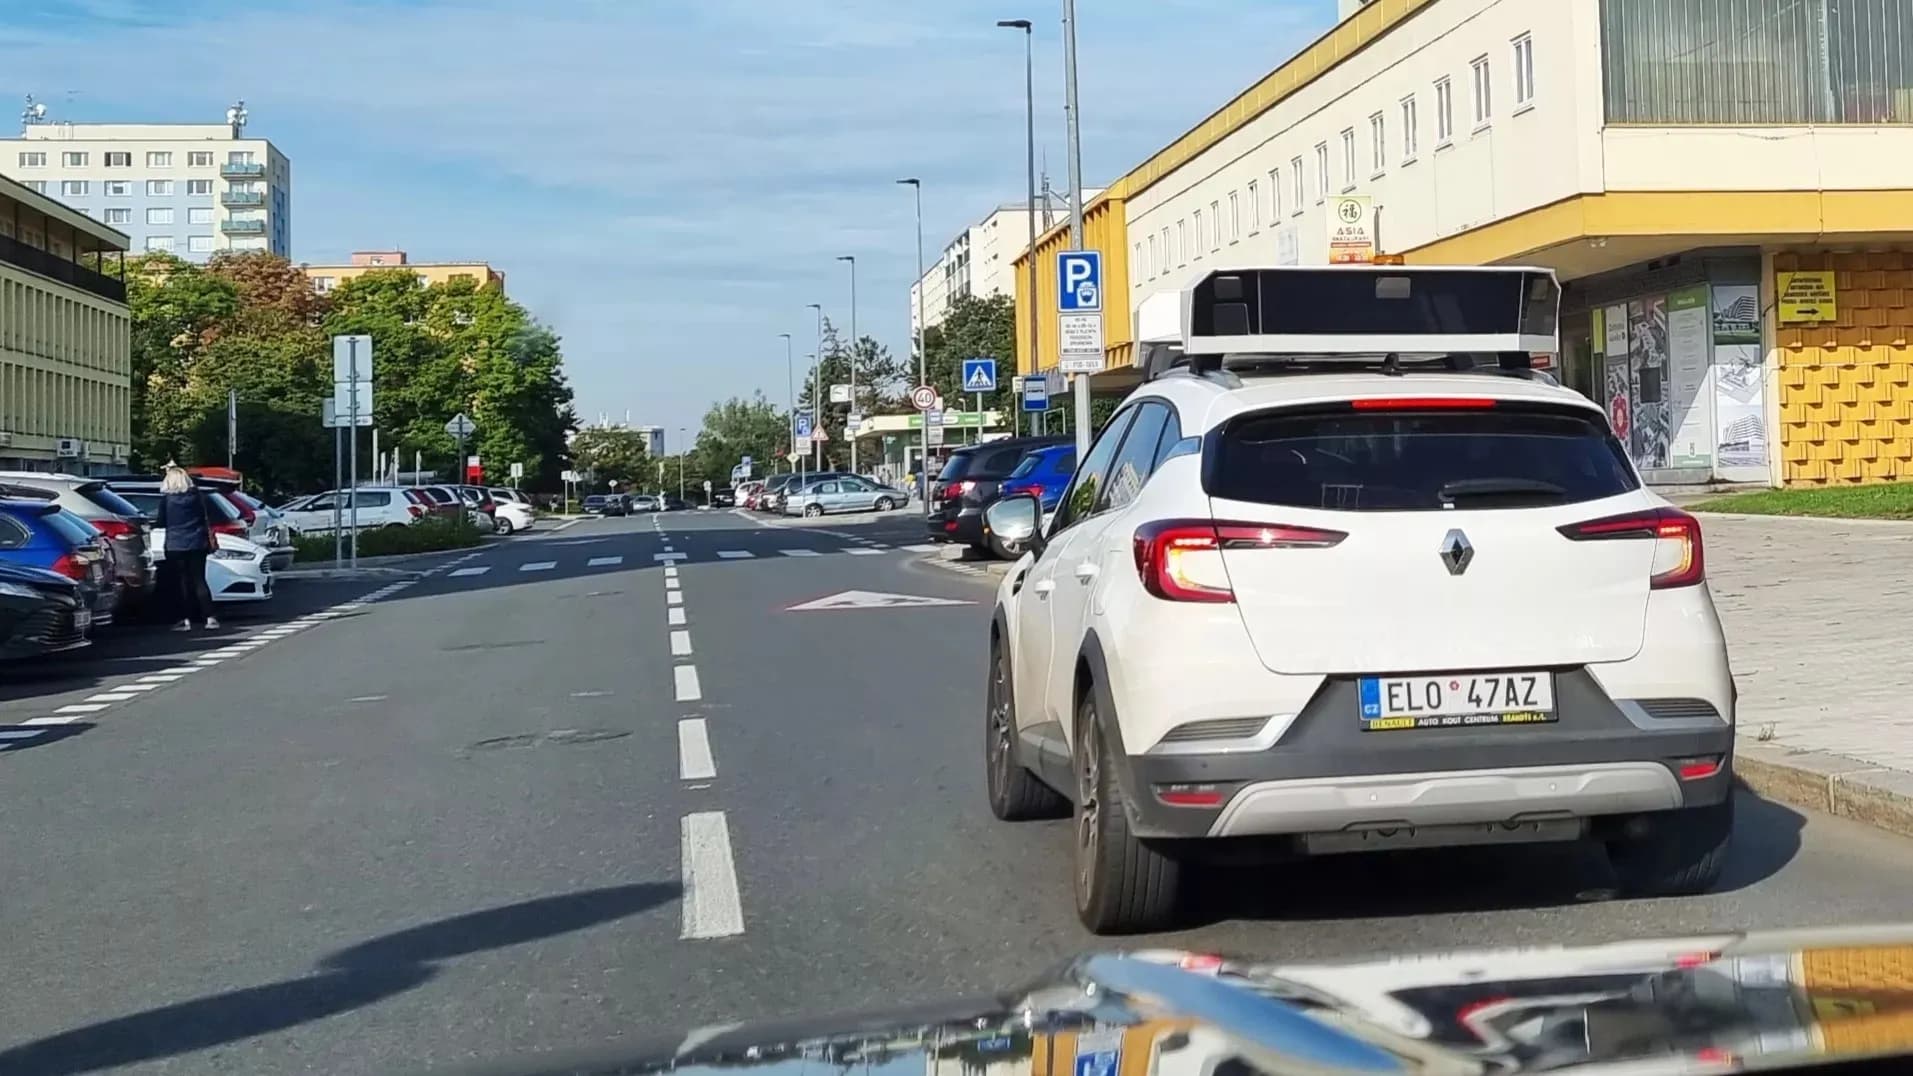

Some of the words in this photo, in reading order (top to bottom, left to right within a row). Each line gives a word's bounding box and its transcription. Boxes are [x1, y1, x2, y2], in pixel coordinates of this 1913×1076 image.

[1336, 226, 1365, 236] ASIA
[1066, 258, 1092, 294] P
[917, 392, 932, 404] 40
[1467, 676, 1539, 709] 47AZ
[1364, 703, 1380, 715] CZ
[1371, 718, 1415, 730] RENAULT
[1418, 718, 1439, 727] AUTO
[1464, 714, 1499, 724] CENTRUM
